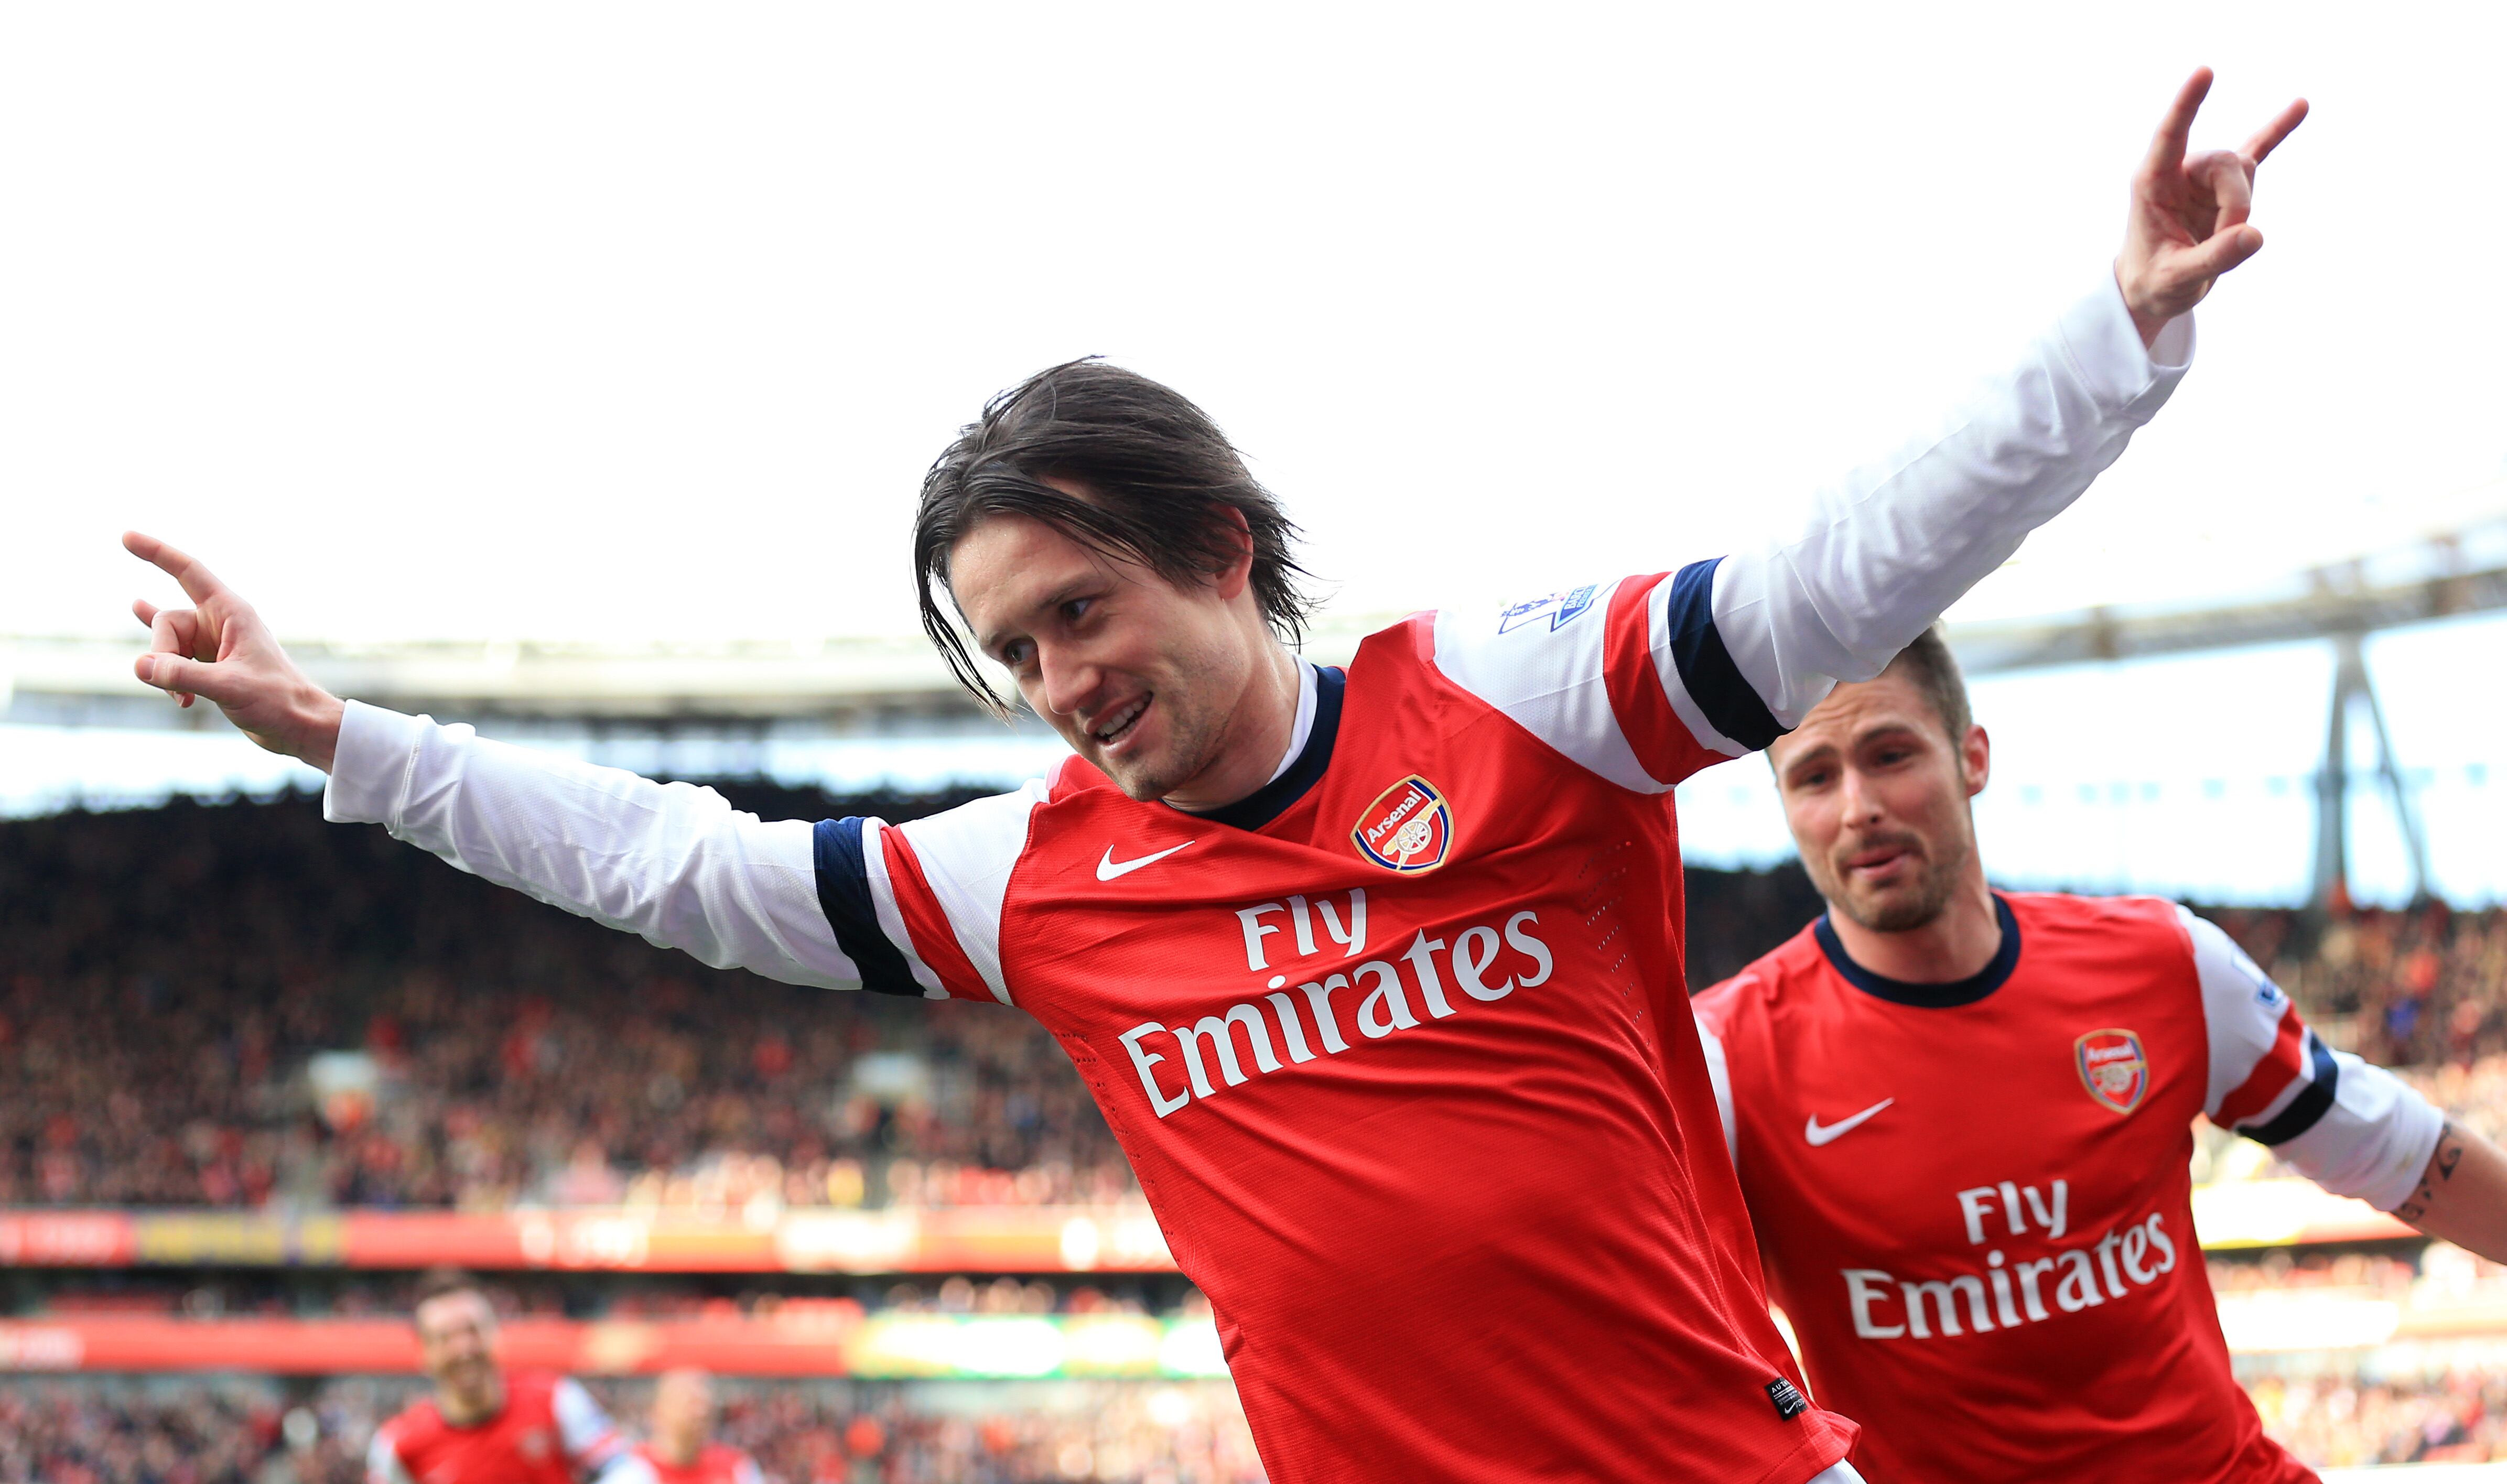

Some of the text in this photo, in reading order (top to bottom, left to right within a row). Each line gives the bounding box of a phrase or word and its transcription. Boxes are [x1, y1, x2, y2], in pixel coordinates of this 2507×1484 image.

[1367, 790, 1422, 843] Arsenal
[1235, 888, 1367, 971] Fly
[1118, 911, 1553, 1119] Emirates
[1957, 1179, 2068, 1245] Fly
[1841, 1212, 2176, 1339] Emirates
